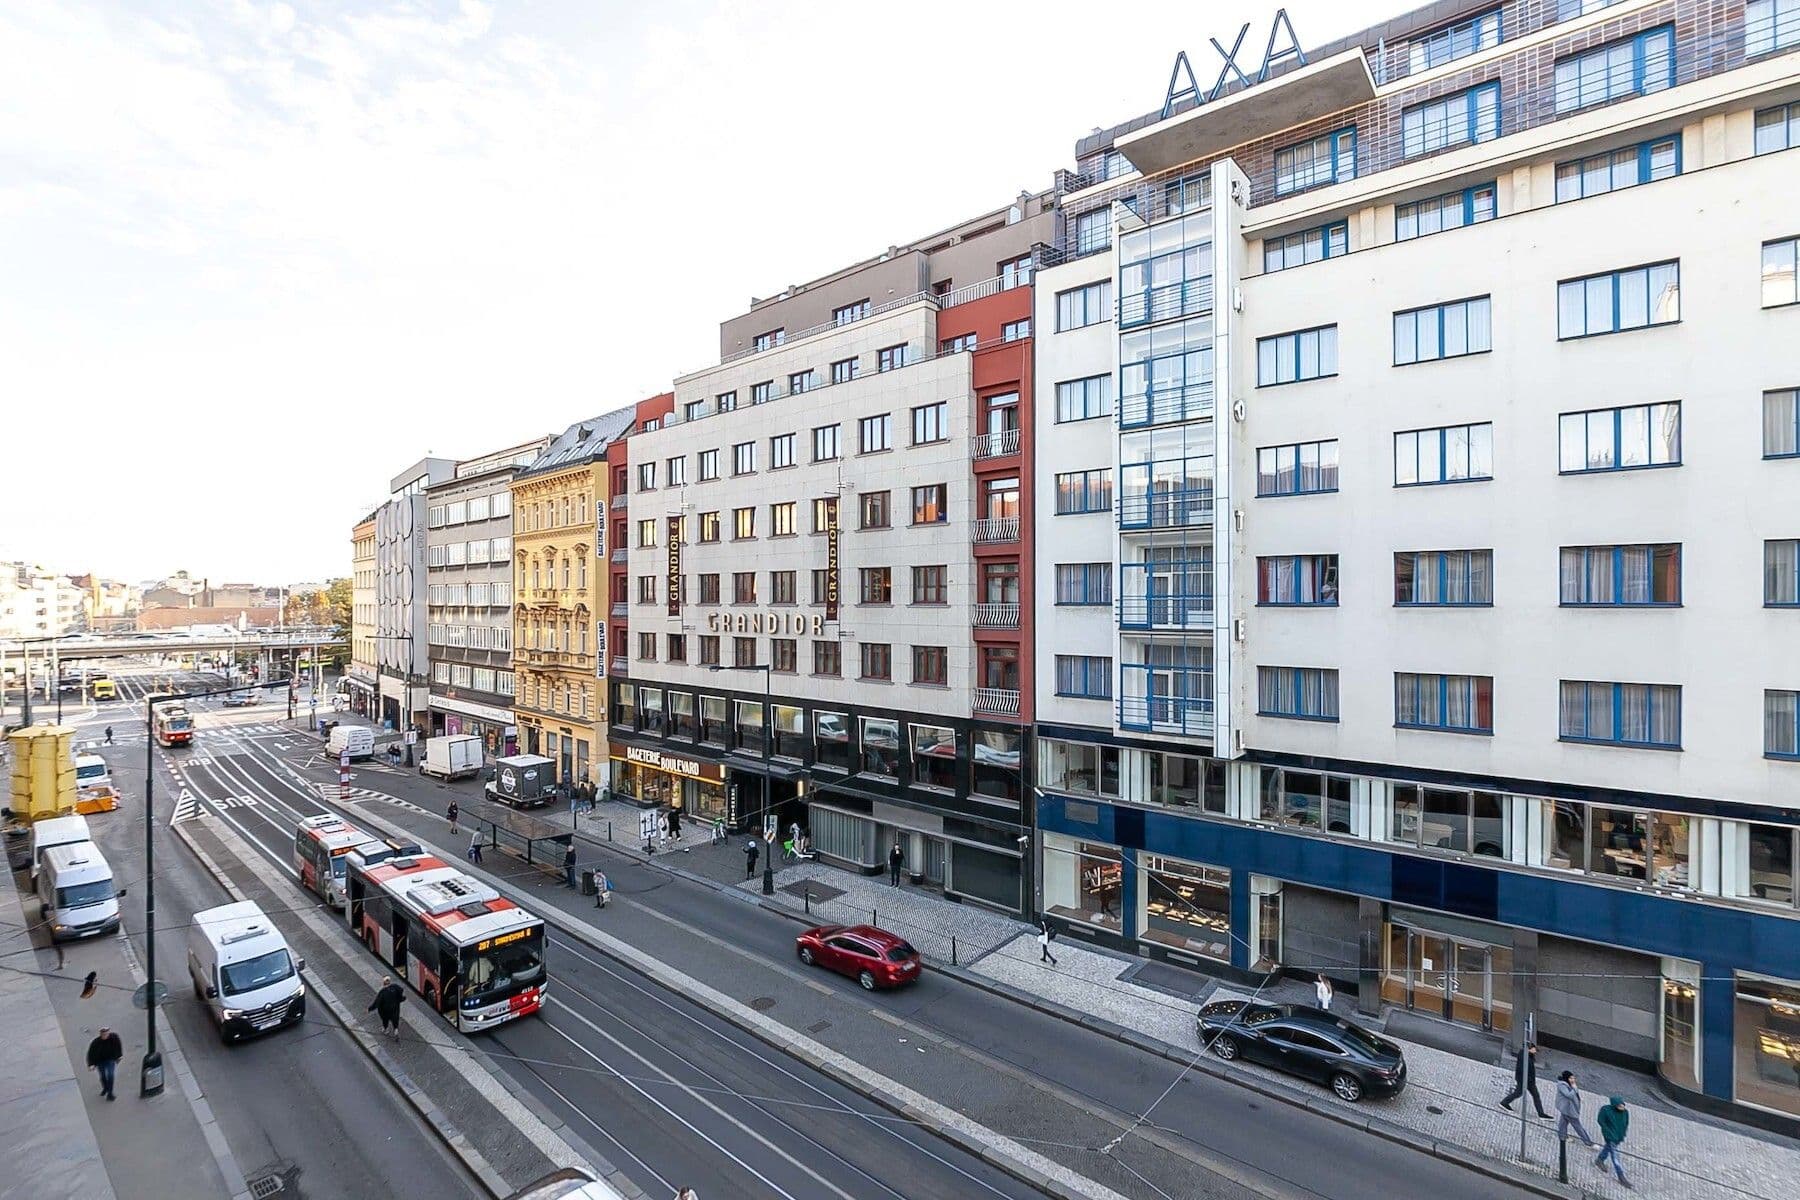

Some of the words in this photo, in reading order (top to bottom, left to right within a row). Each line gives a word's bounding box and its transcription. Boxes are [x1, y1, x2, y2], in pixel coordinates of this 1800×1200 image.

[1160, 8, 1308, 120] AXA
[670, 534, 679, 601] GRANDIOR
[828, 520, 837, 602] GRANDIOR
[708, 612, 824, 636] GRANDIOR
[627, 746, 660, 765] BAGETERIE
[660, 757, 699, 776] BOULEVARD
[212, 795, 258, 810] BUS
